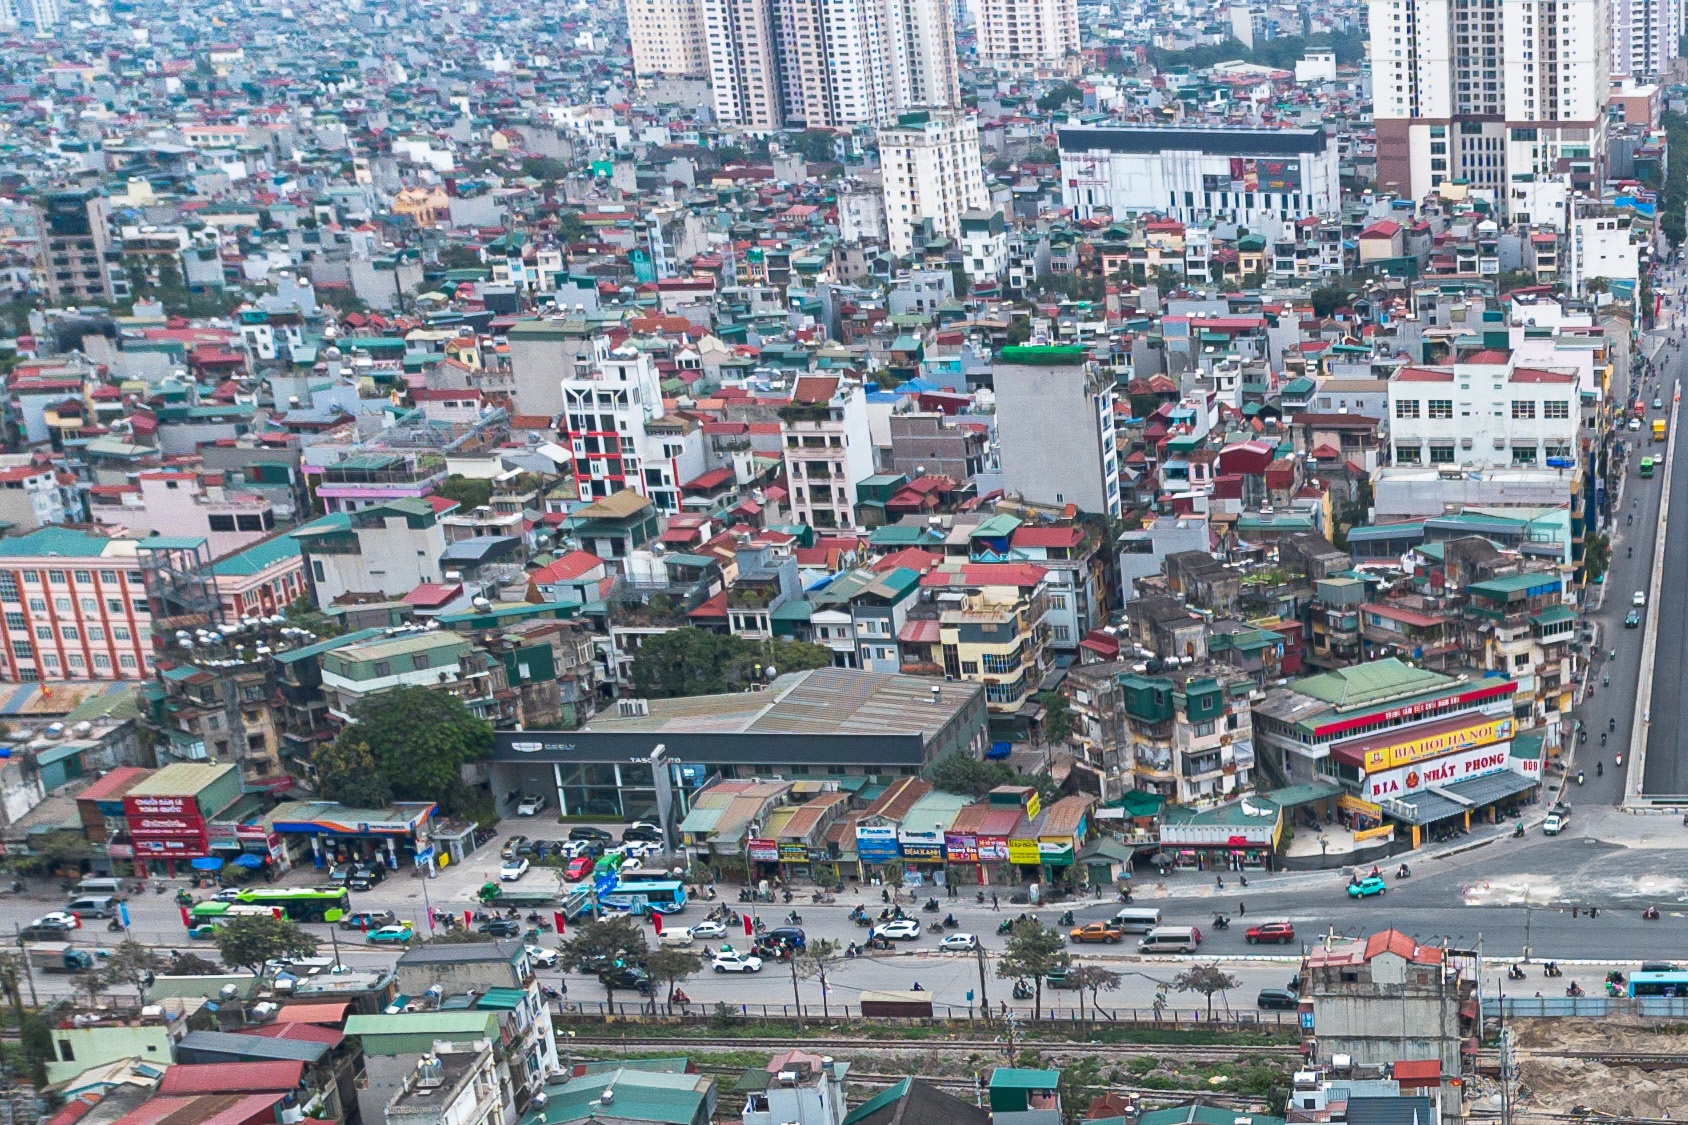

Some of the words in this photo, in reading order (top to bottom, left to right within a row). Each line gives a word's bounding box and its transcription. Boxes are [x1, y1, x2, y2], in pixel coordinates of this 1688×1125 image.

[1394, 745, 1416, 758] BIA
[1448, 730, 1466, 745] HÀ
[1373, 780, 1398, 795] BIA
[1424, 762, 1456, 781] NHẤT
[1465, 753, 1504, 773] PHONG
